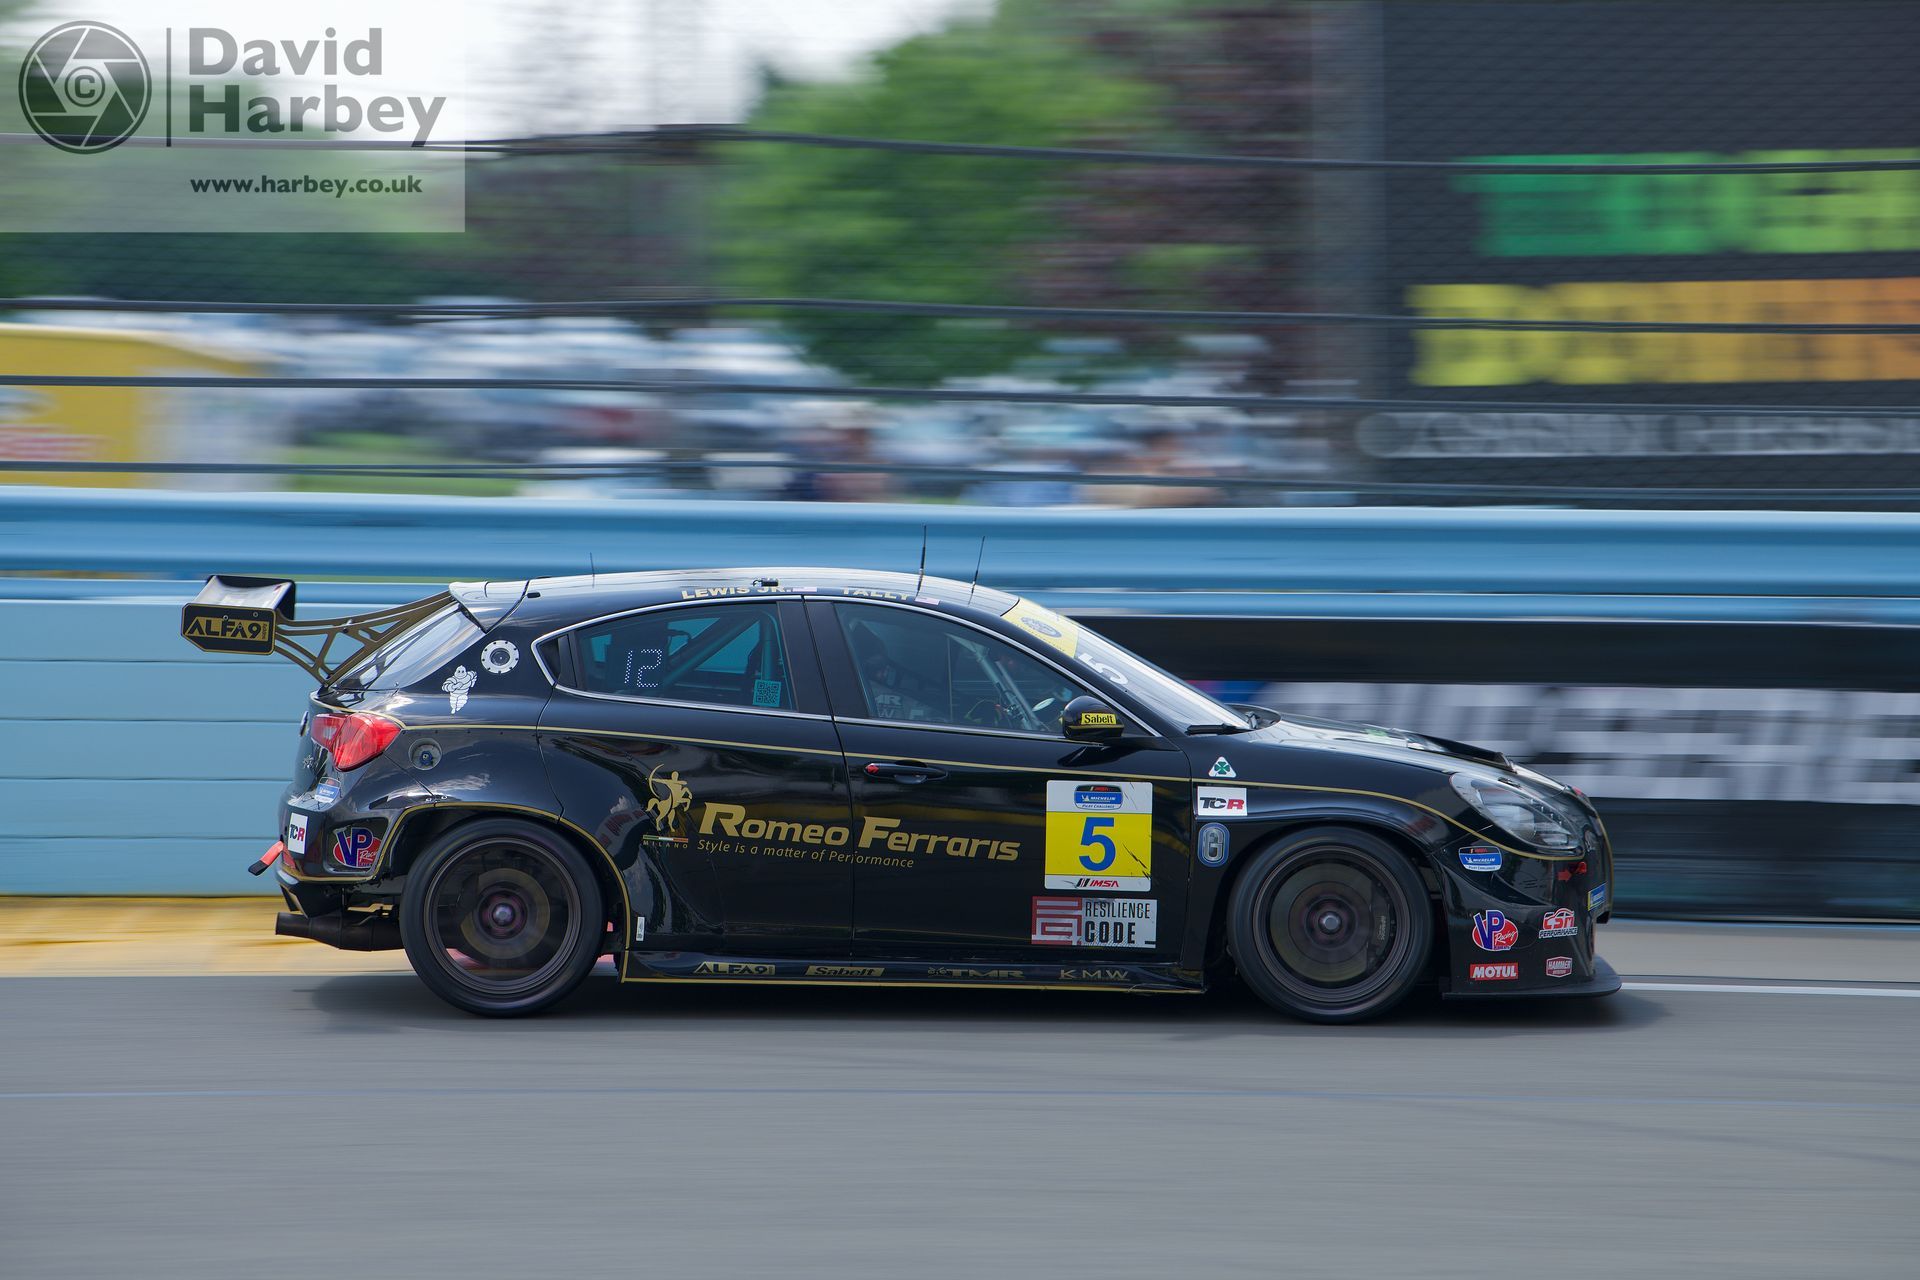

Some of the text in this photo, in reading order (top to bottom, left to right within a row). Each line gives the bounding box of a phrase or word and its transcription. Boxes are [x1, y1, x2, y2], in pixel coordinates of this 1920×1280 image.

[681, 586, 750, 600] LEWIS
[187, 618, 262, 639] ALFA9
[1084, 714, 1113, 724] Sabelt
[1199, 797, 1245, 810] TCR
[290, 824, 305, 841] TCR
[699, 801, 1021, 862] Romeo Ferraris
[336, 827, 373, 867] VP
[643, 841, 688, 849] MILANO
[698, 840, 730, 854] Style
[735, 842, 745, 853] is
[763, 846, 806, 859] matter
[812, 850, 824, 862] of
[1079, 817, 1116, 872] 5
[1089, 880, 1119, 888] IMSA
[1085, 902, 1150, 918] RESILIENCE
[1084, 921, 1136, 944] CODE
[1474, 910, 1505, 950] VP
[1494, 931, 1517, 944] Racing
[696, 964, 764, 974] ALFA9
[814, 967, 876, 976] Sabelt
[1472, 965, 1517, 979] MOTUL
